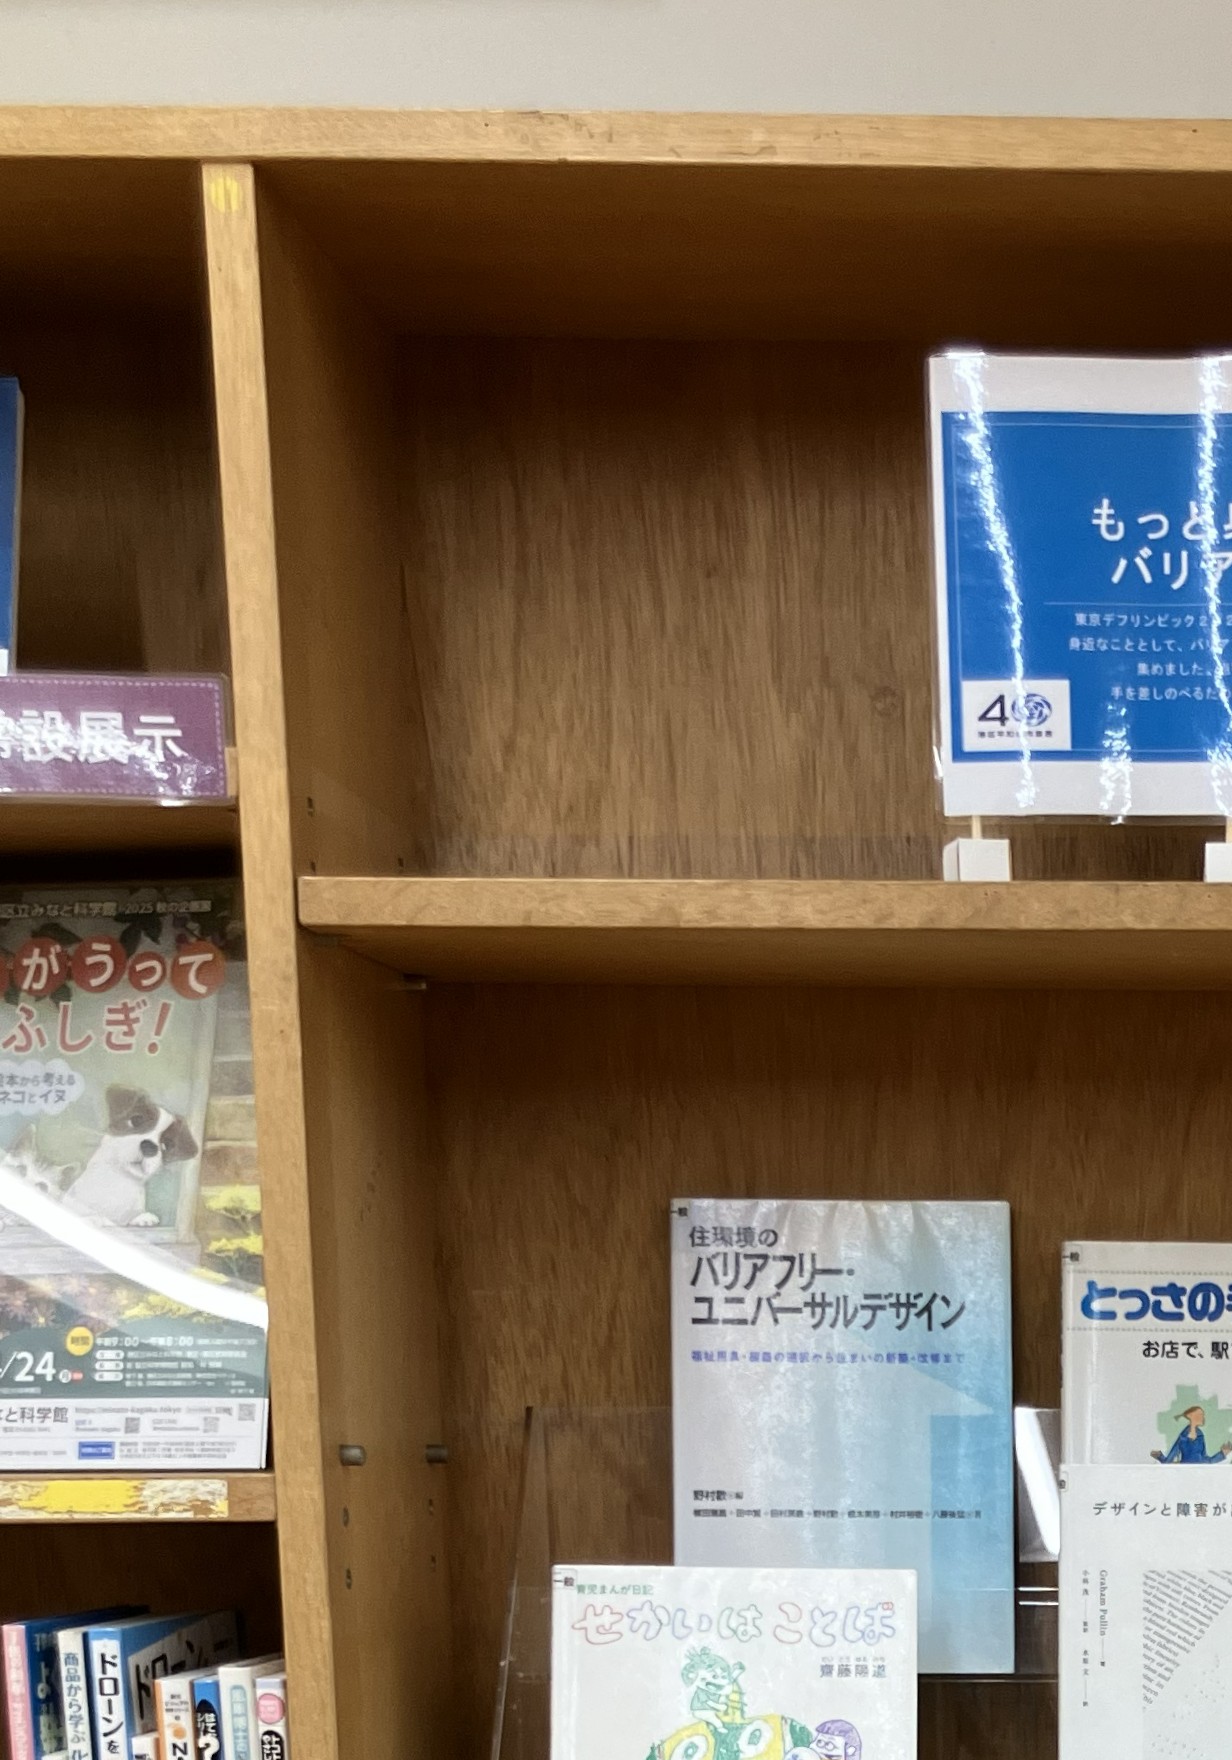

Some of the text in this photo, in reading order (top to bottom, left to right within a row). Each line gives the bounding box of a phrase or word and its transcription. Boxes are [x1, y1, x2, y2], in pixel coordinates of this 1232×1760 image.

[689, 1226, 778, 1247] 住環境の
[691, 1291, 966, 1331] ユニバーサルデザイン
[1100, 1569, 1108, 1636] Graham Pullin
